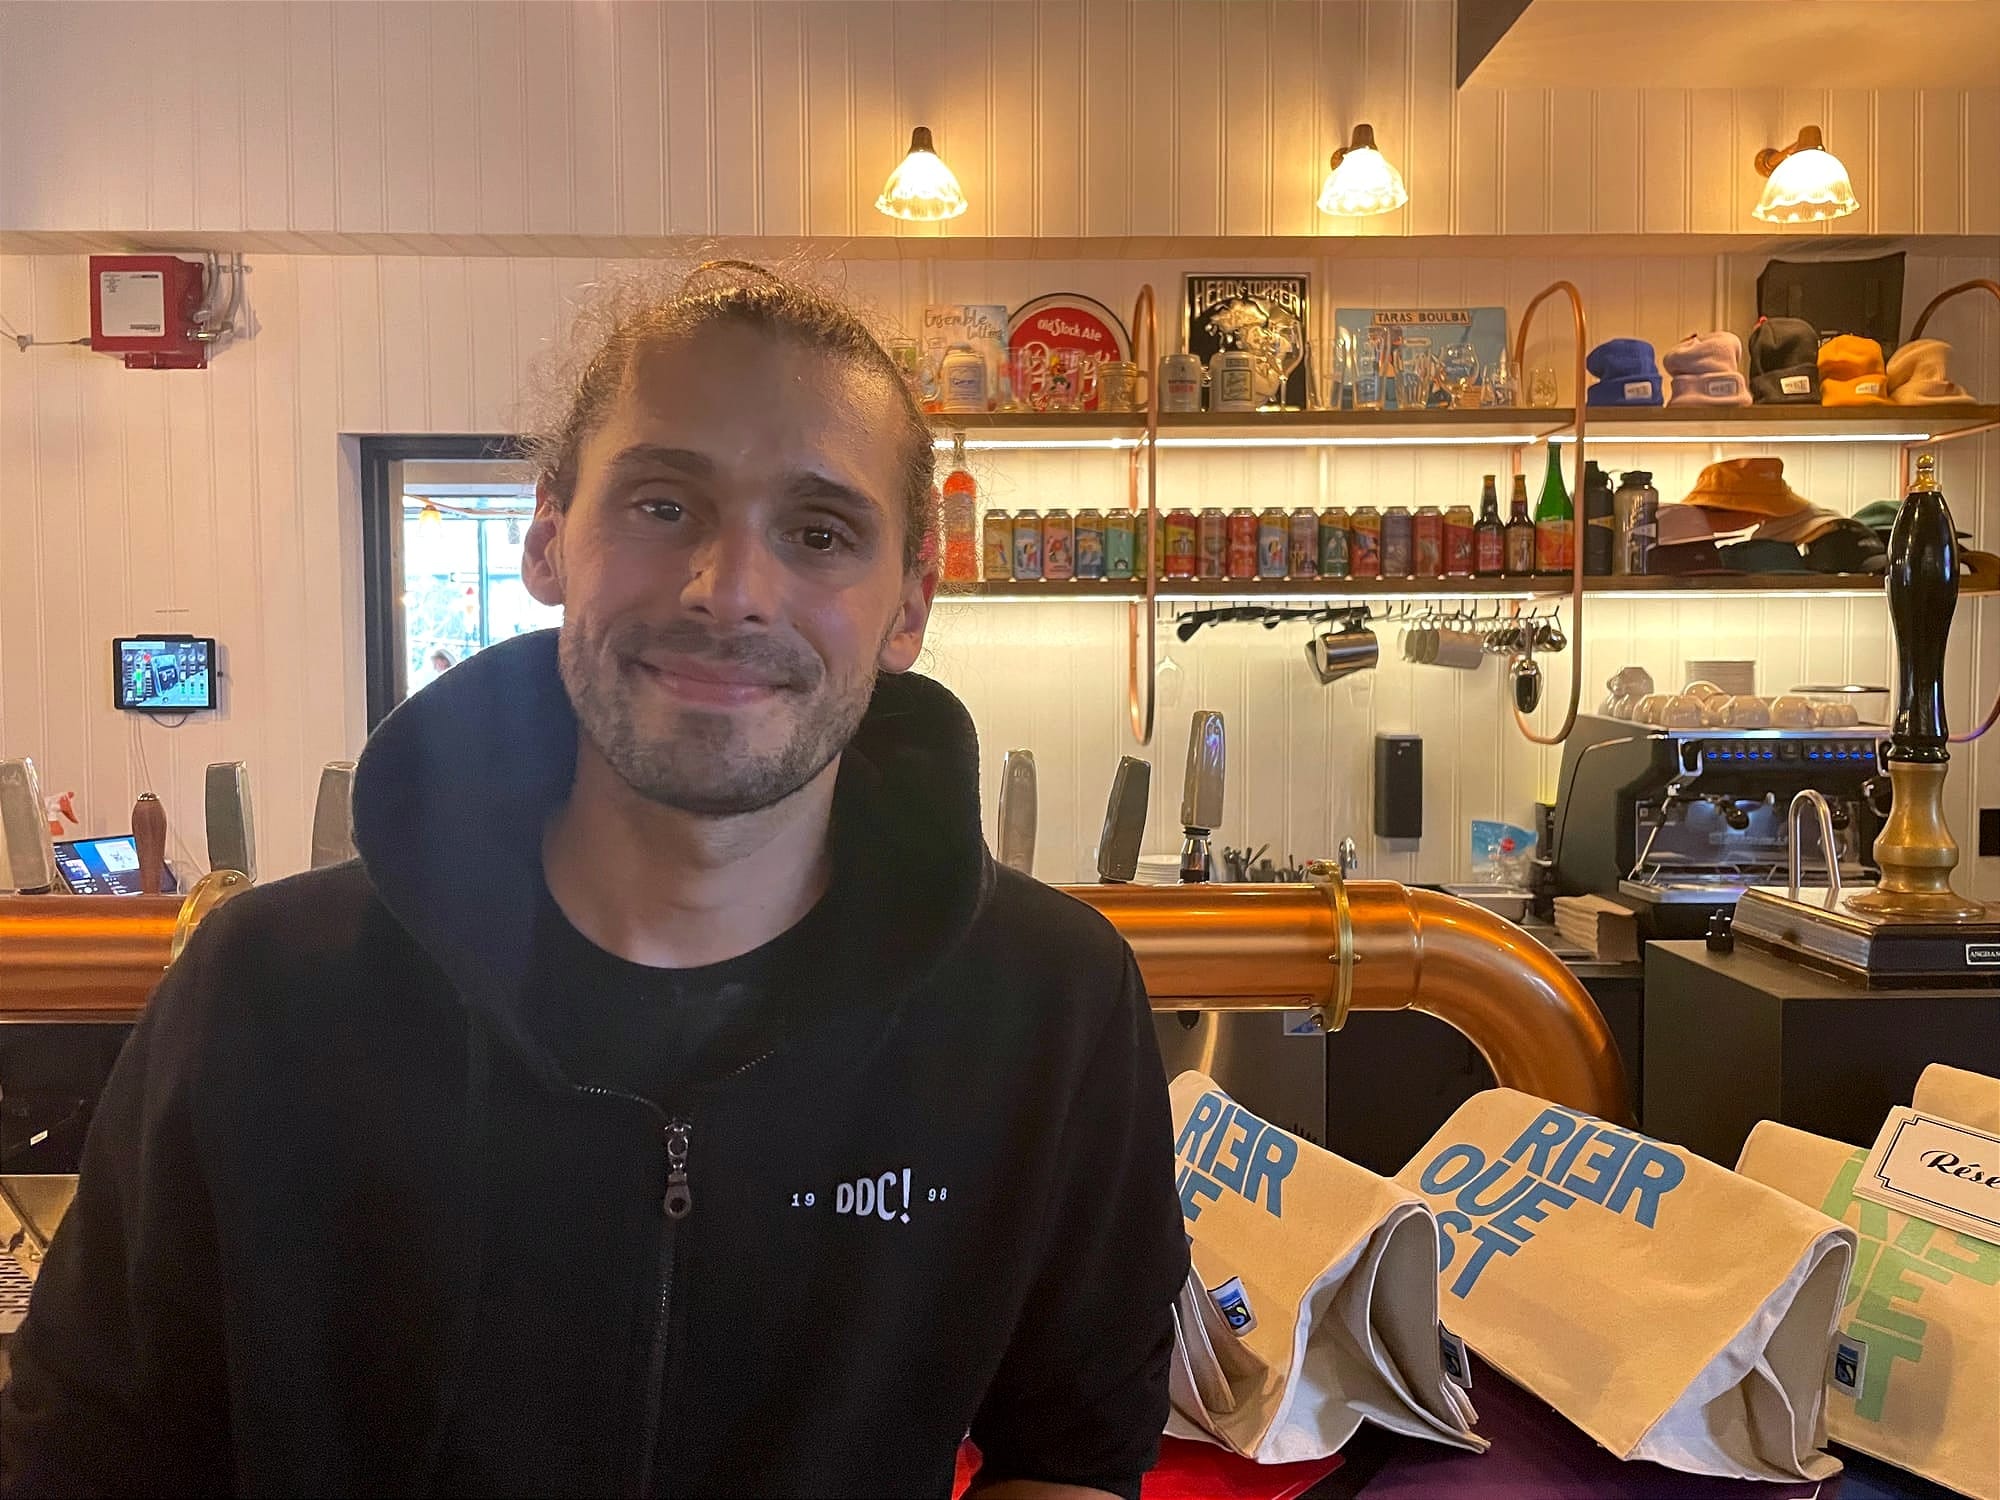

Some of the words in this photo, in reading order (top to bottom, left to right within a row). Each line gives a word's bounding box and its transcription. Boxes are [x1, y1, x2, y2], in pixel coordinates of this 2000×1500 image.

[1037, 319, 1053, 332] Old
[1051, 318, 1080, 337] Stock
[1081, 327, 1102, 341] Ale
[1377, 312, 1413, 322] TARAS
[1419, 312, 1467, 322] BOULBA
[791, 1192, 815, 1207] 19
[836, 1168, 911, 1224] DDC!
[928, 1187, 947, 1202] 98
[1420, 1144, 1576, 1242] OUE
